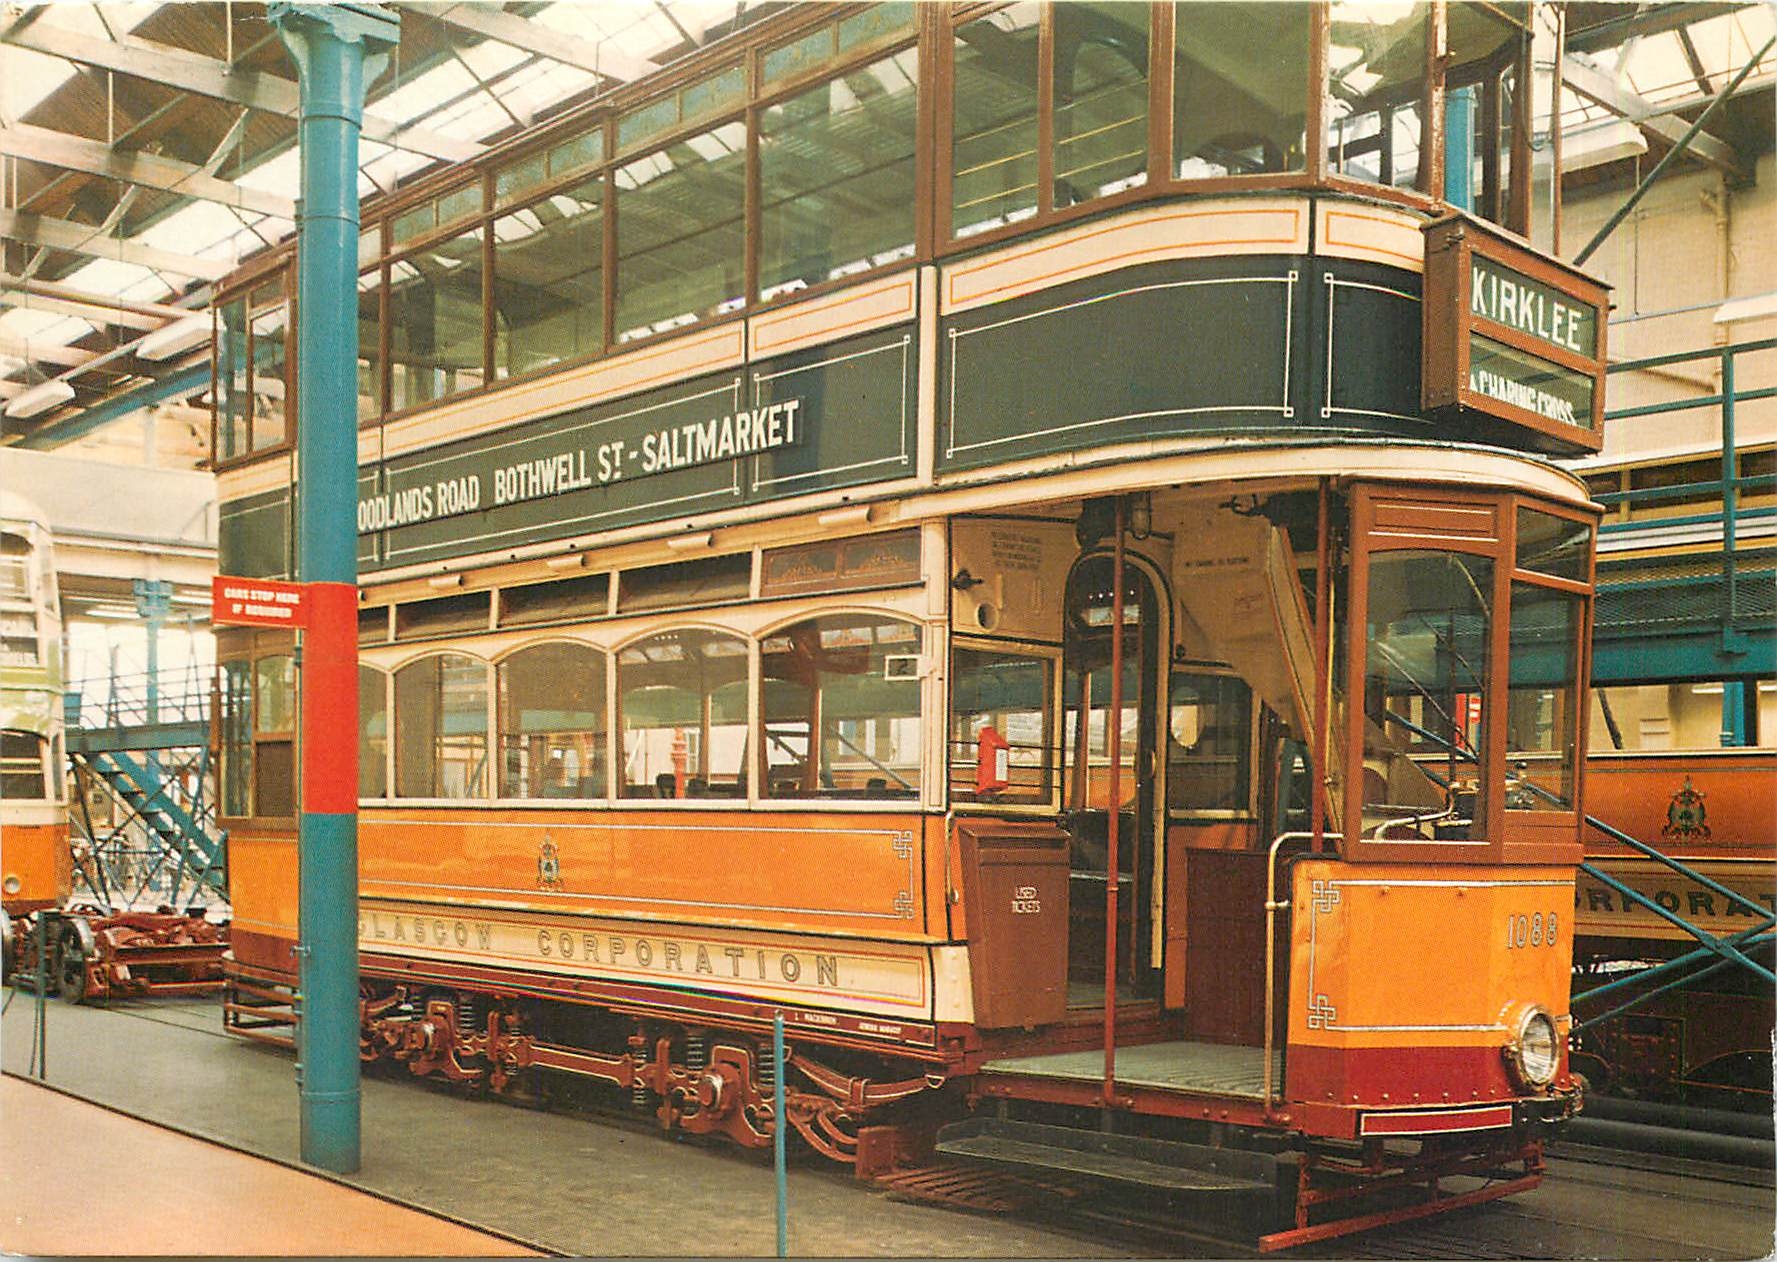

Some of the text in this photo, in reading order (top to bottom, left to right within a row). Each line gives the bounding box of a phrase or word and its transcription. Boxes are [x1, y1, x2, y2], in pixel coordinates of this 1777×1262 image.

[1472, 266, 1582, 352] KIRKLEE
[357, 485, 433, 532] OODLANDS
[437, 475, 480, 517] ROAD
[494, 450, 592, 505] BOTHWELL
[642, 400, 800, 473] SALTMARKET
[537, 929, 838, 987] CORPORATION
[1507, 911, 1559, 949] 1088
